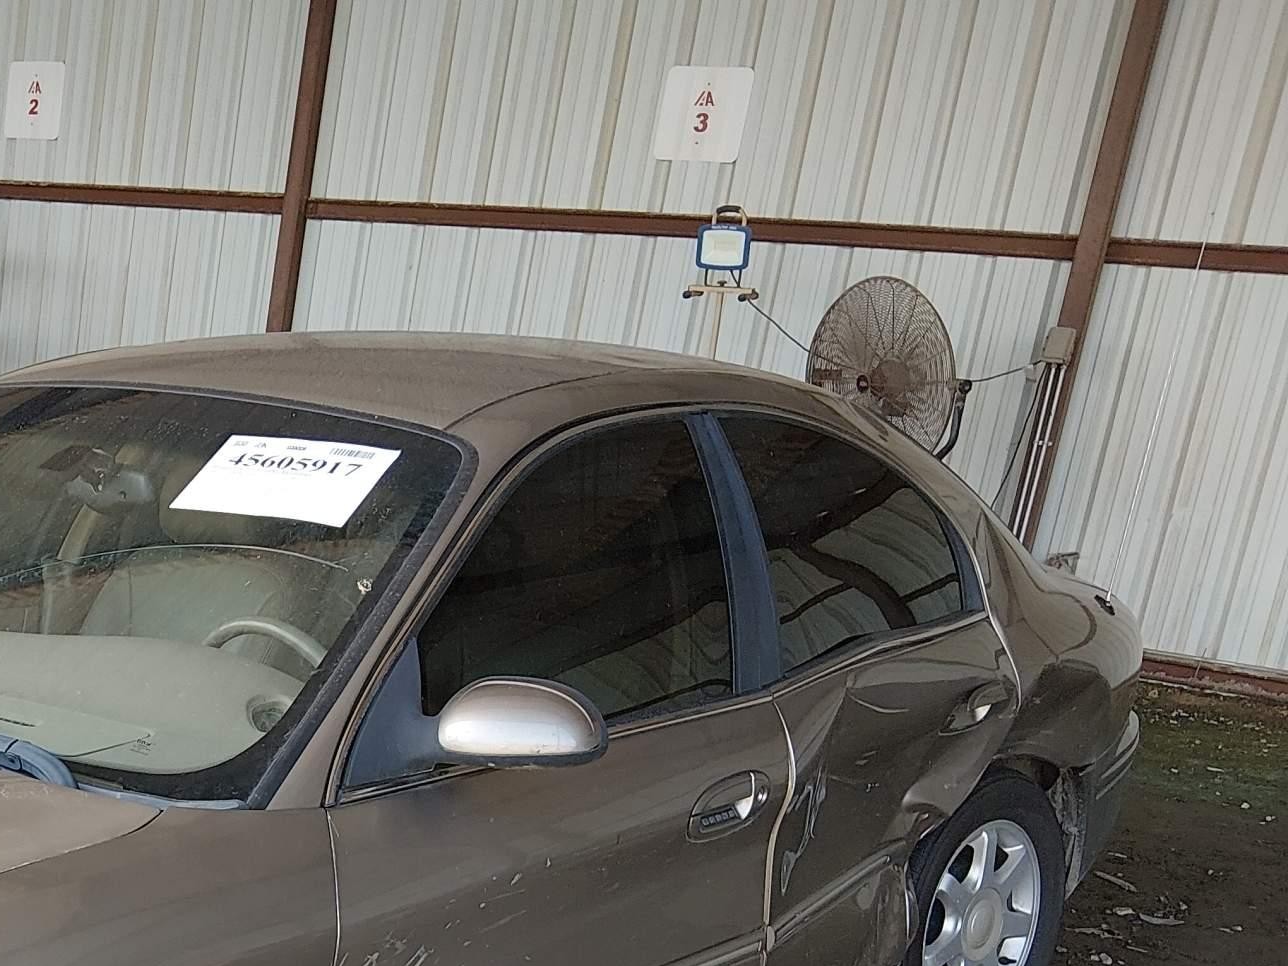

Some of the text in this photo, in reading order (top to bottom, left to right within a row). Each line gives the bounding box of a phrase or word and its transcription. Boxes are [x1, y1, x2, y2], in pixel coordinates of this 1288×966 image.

[28, 98, 39, 115] 2
[693, 112, 709, 133] 3
[228, 452, 364, 477] 45605917
